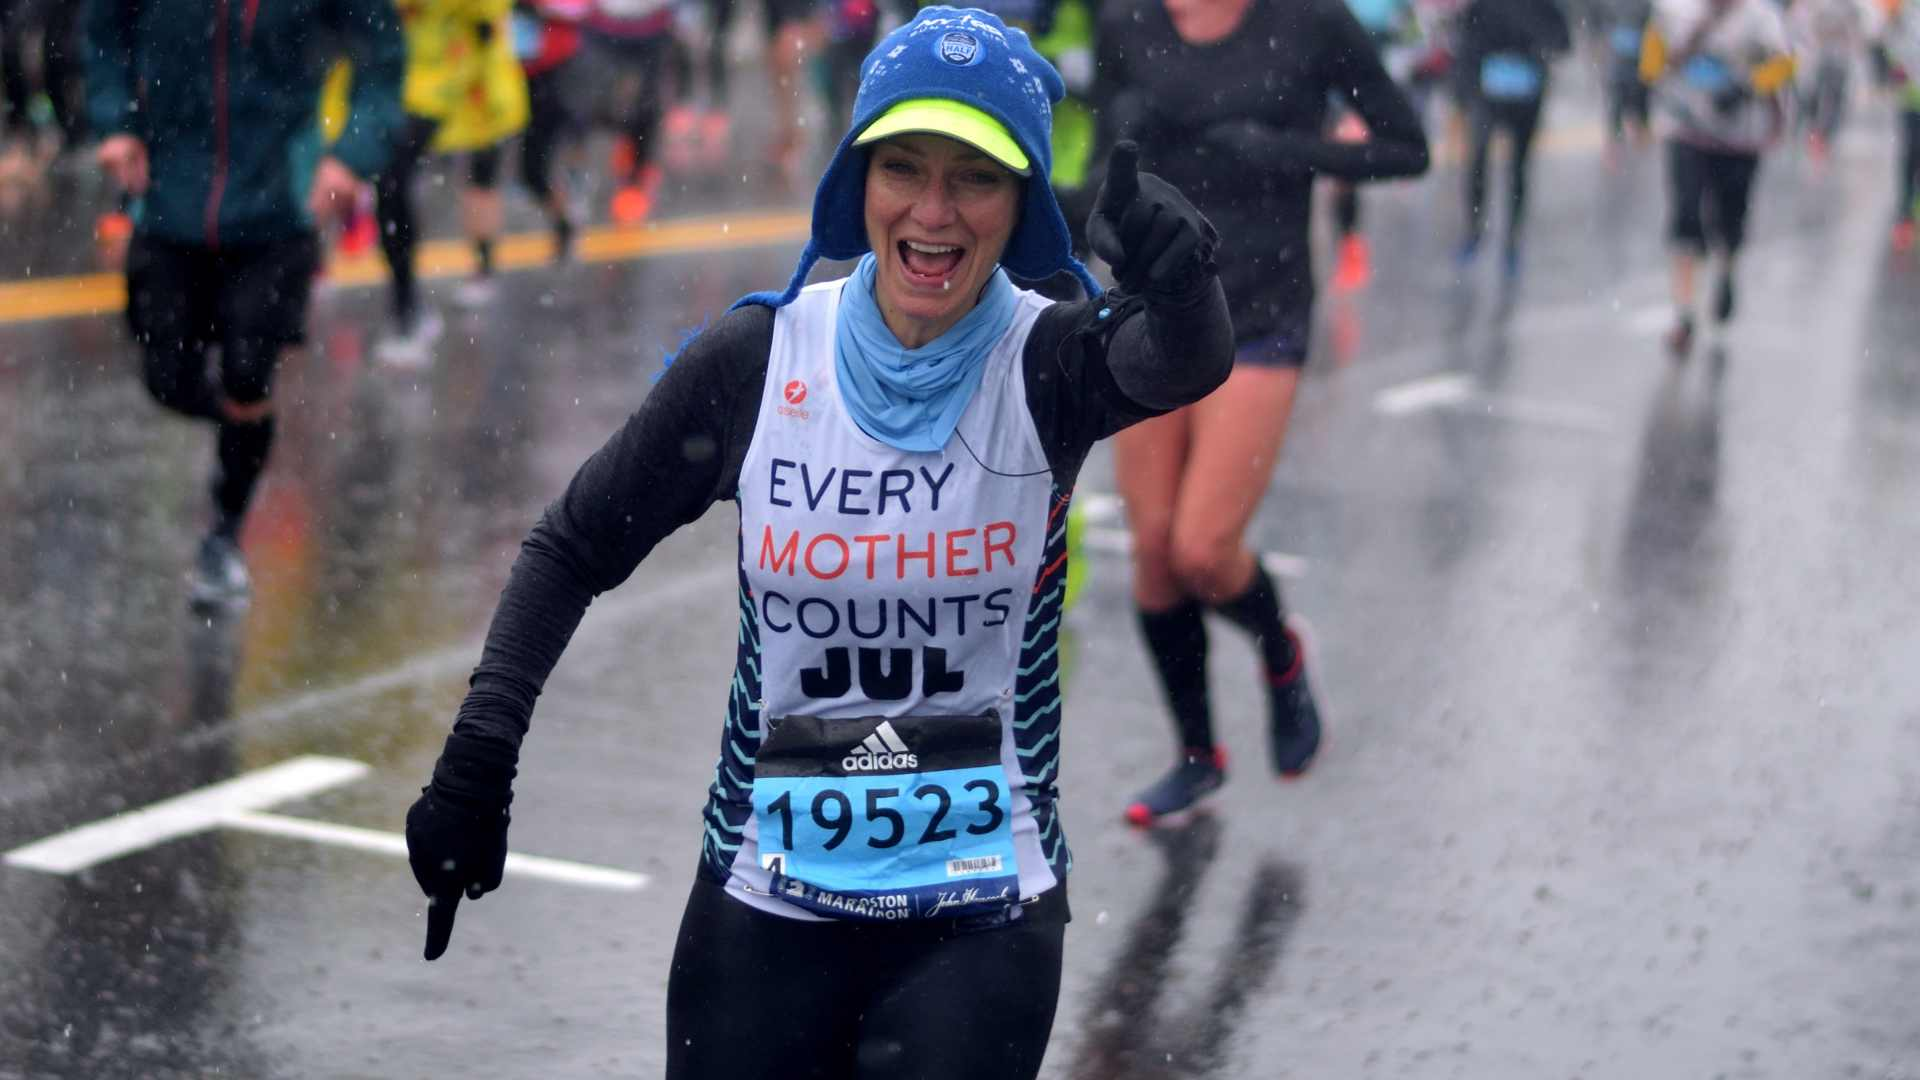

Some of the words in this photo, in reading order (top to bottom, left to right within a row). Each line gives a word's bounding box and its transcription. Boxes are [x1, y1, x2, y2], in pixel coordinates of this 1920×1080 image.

[946, 44, 974, 54] HALF
[769, 458, 955, 515] EVERY
[759, 520, 1017, 580] MOTHER
[762, 588, 1013, 639] COUNTS
[799, 645, 965, 701] JUL
[841, 752, 919, 771] adidas
[767, 779, 1004, 851] 19523
[858, 893, 908, 909] OSTON
